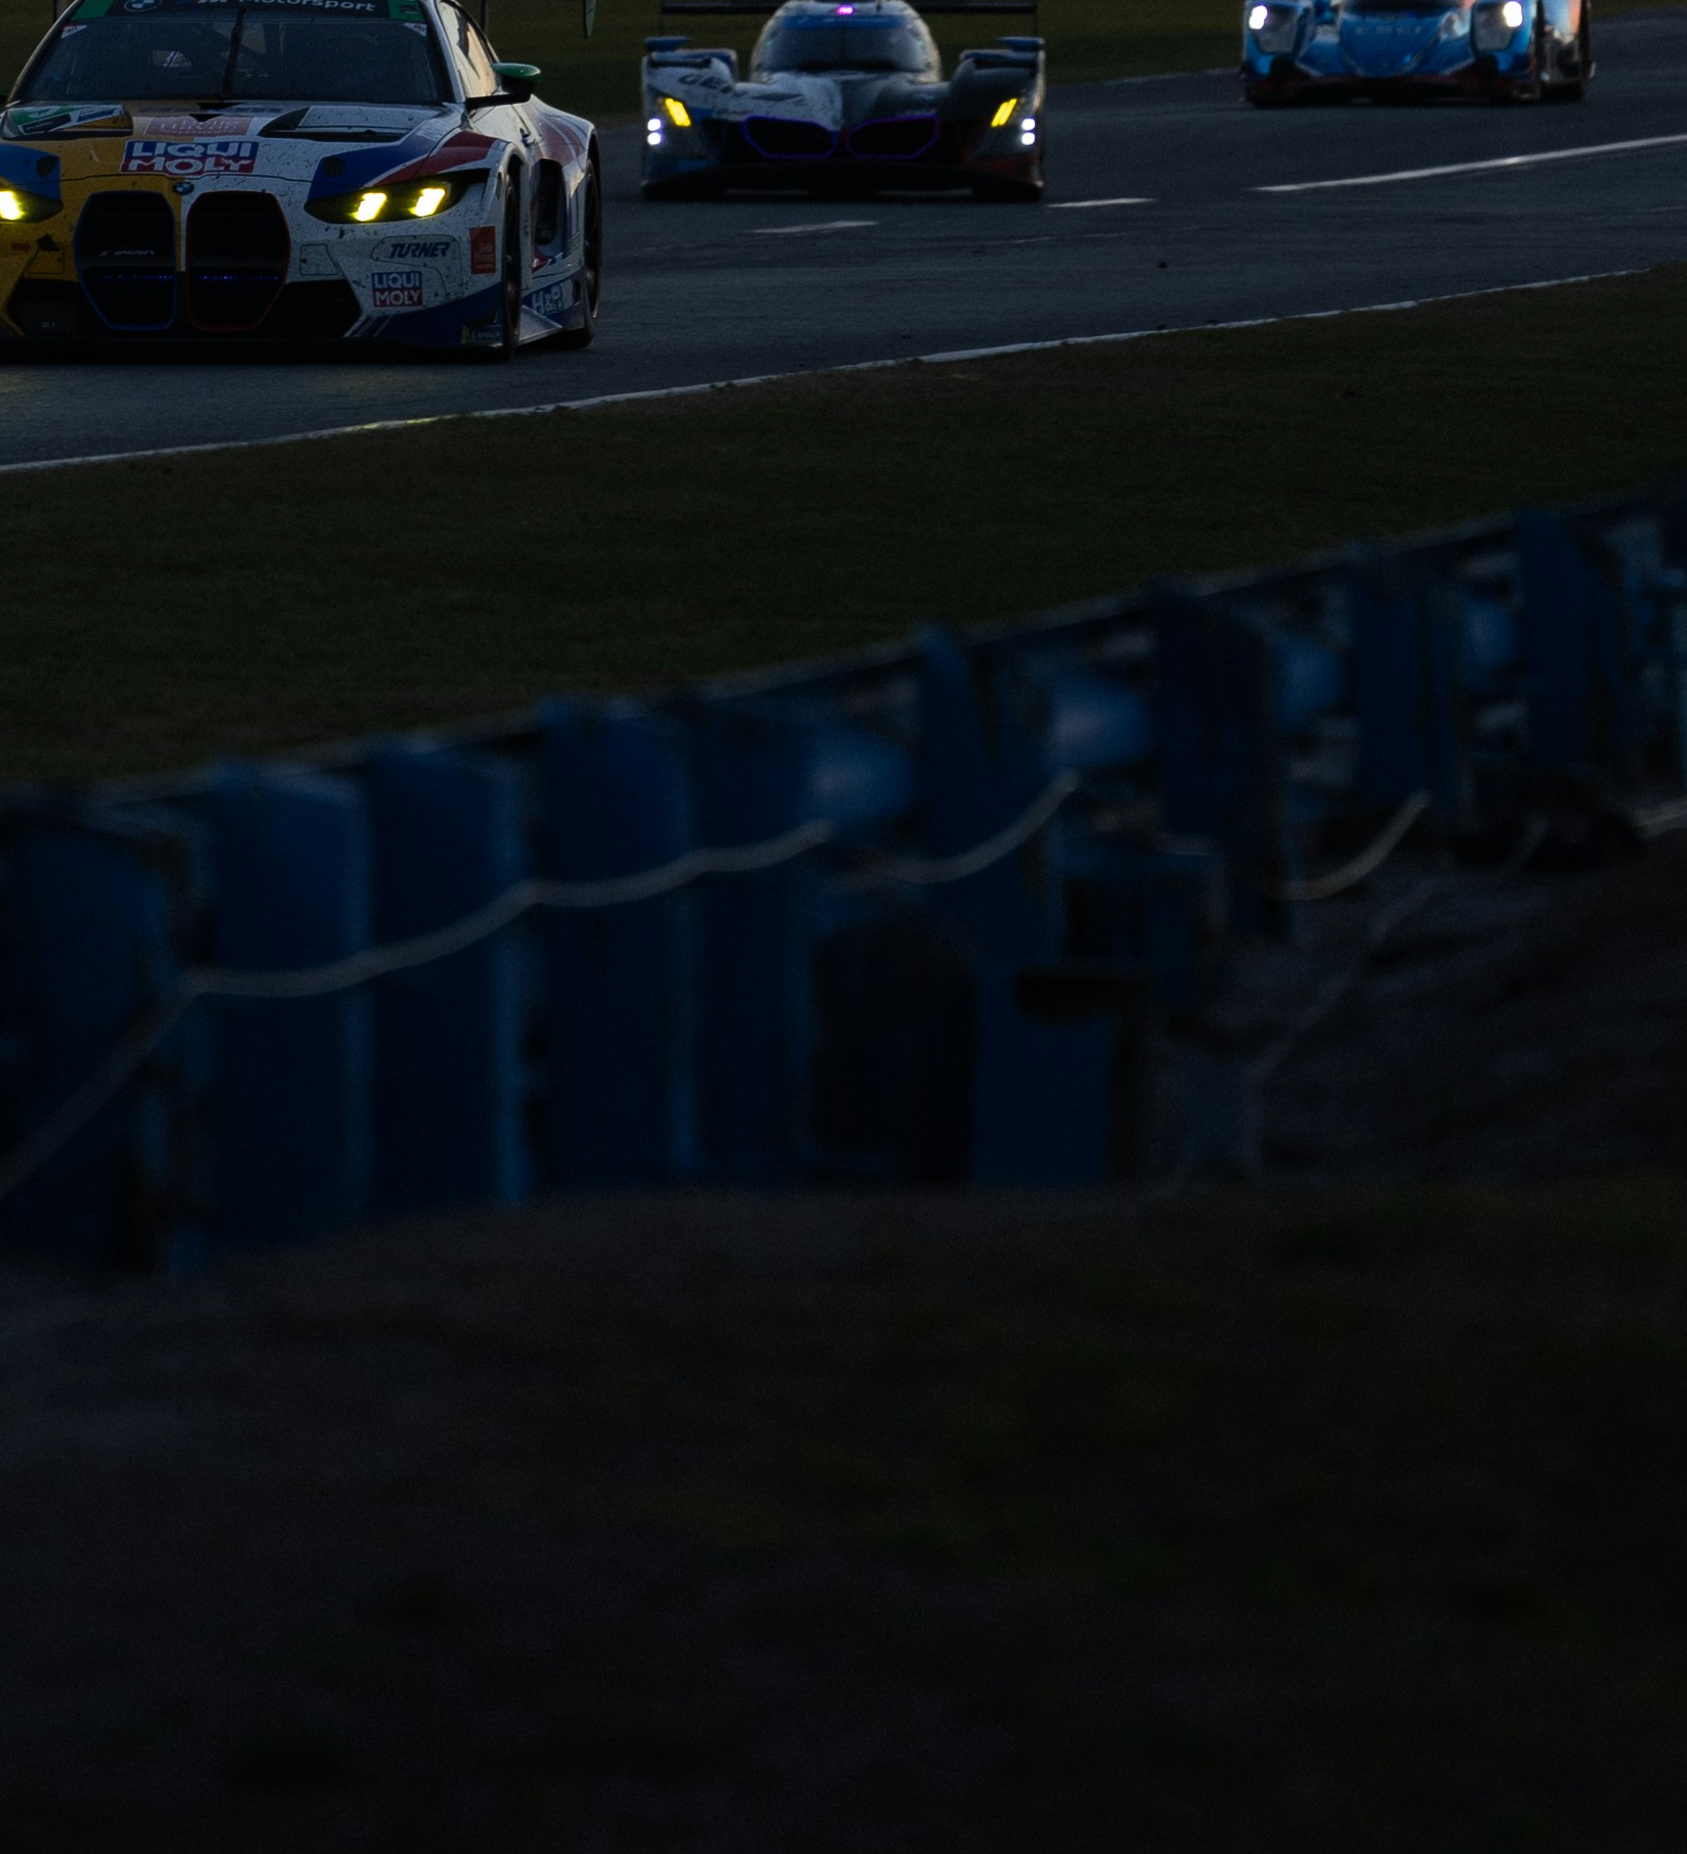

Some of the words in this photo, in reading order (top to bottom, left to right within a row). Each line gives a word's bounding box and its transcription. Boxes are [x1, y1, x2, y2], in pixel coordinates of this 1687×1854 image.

[130, 141, 251, 158] LIQUI
[127, 158, 252, 172] MOLY
[390, 242, 450, 258] TURNER
[374, 273, 420, 288] LIQUI
[375, 290, 421, 306] MOLY
